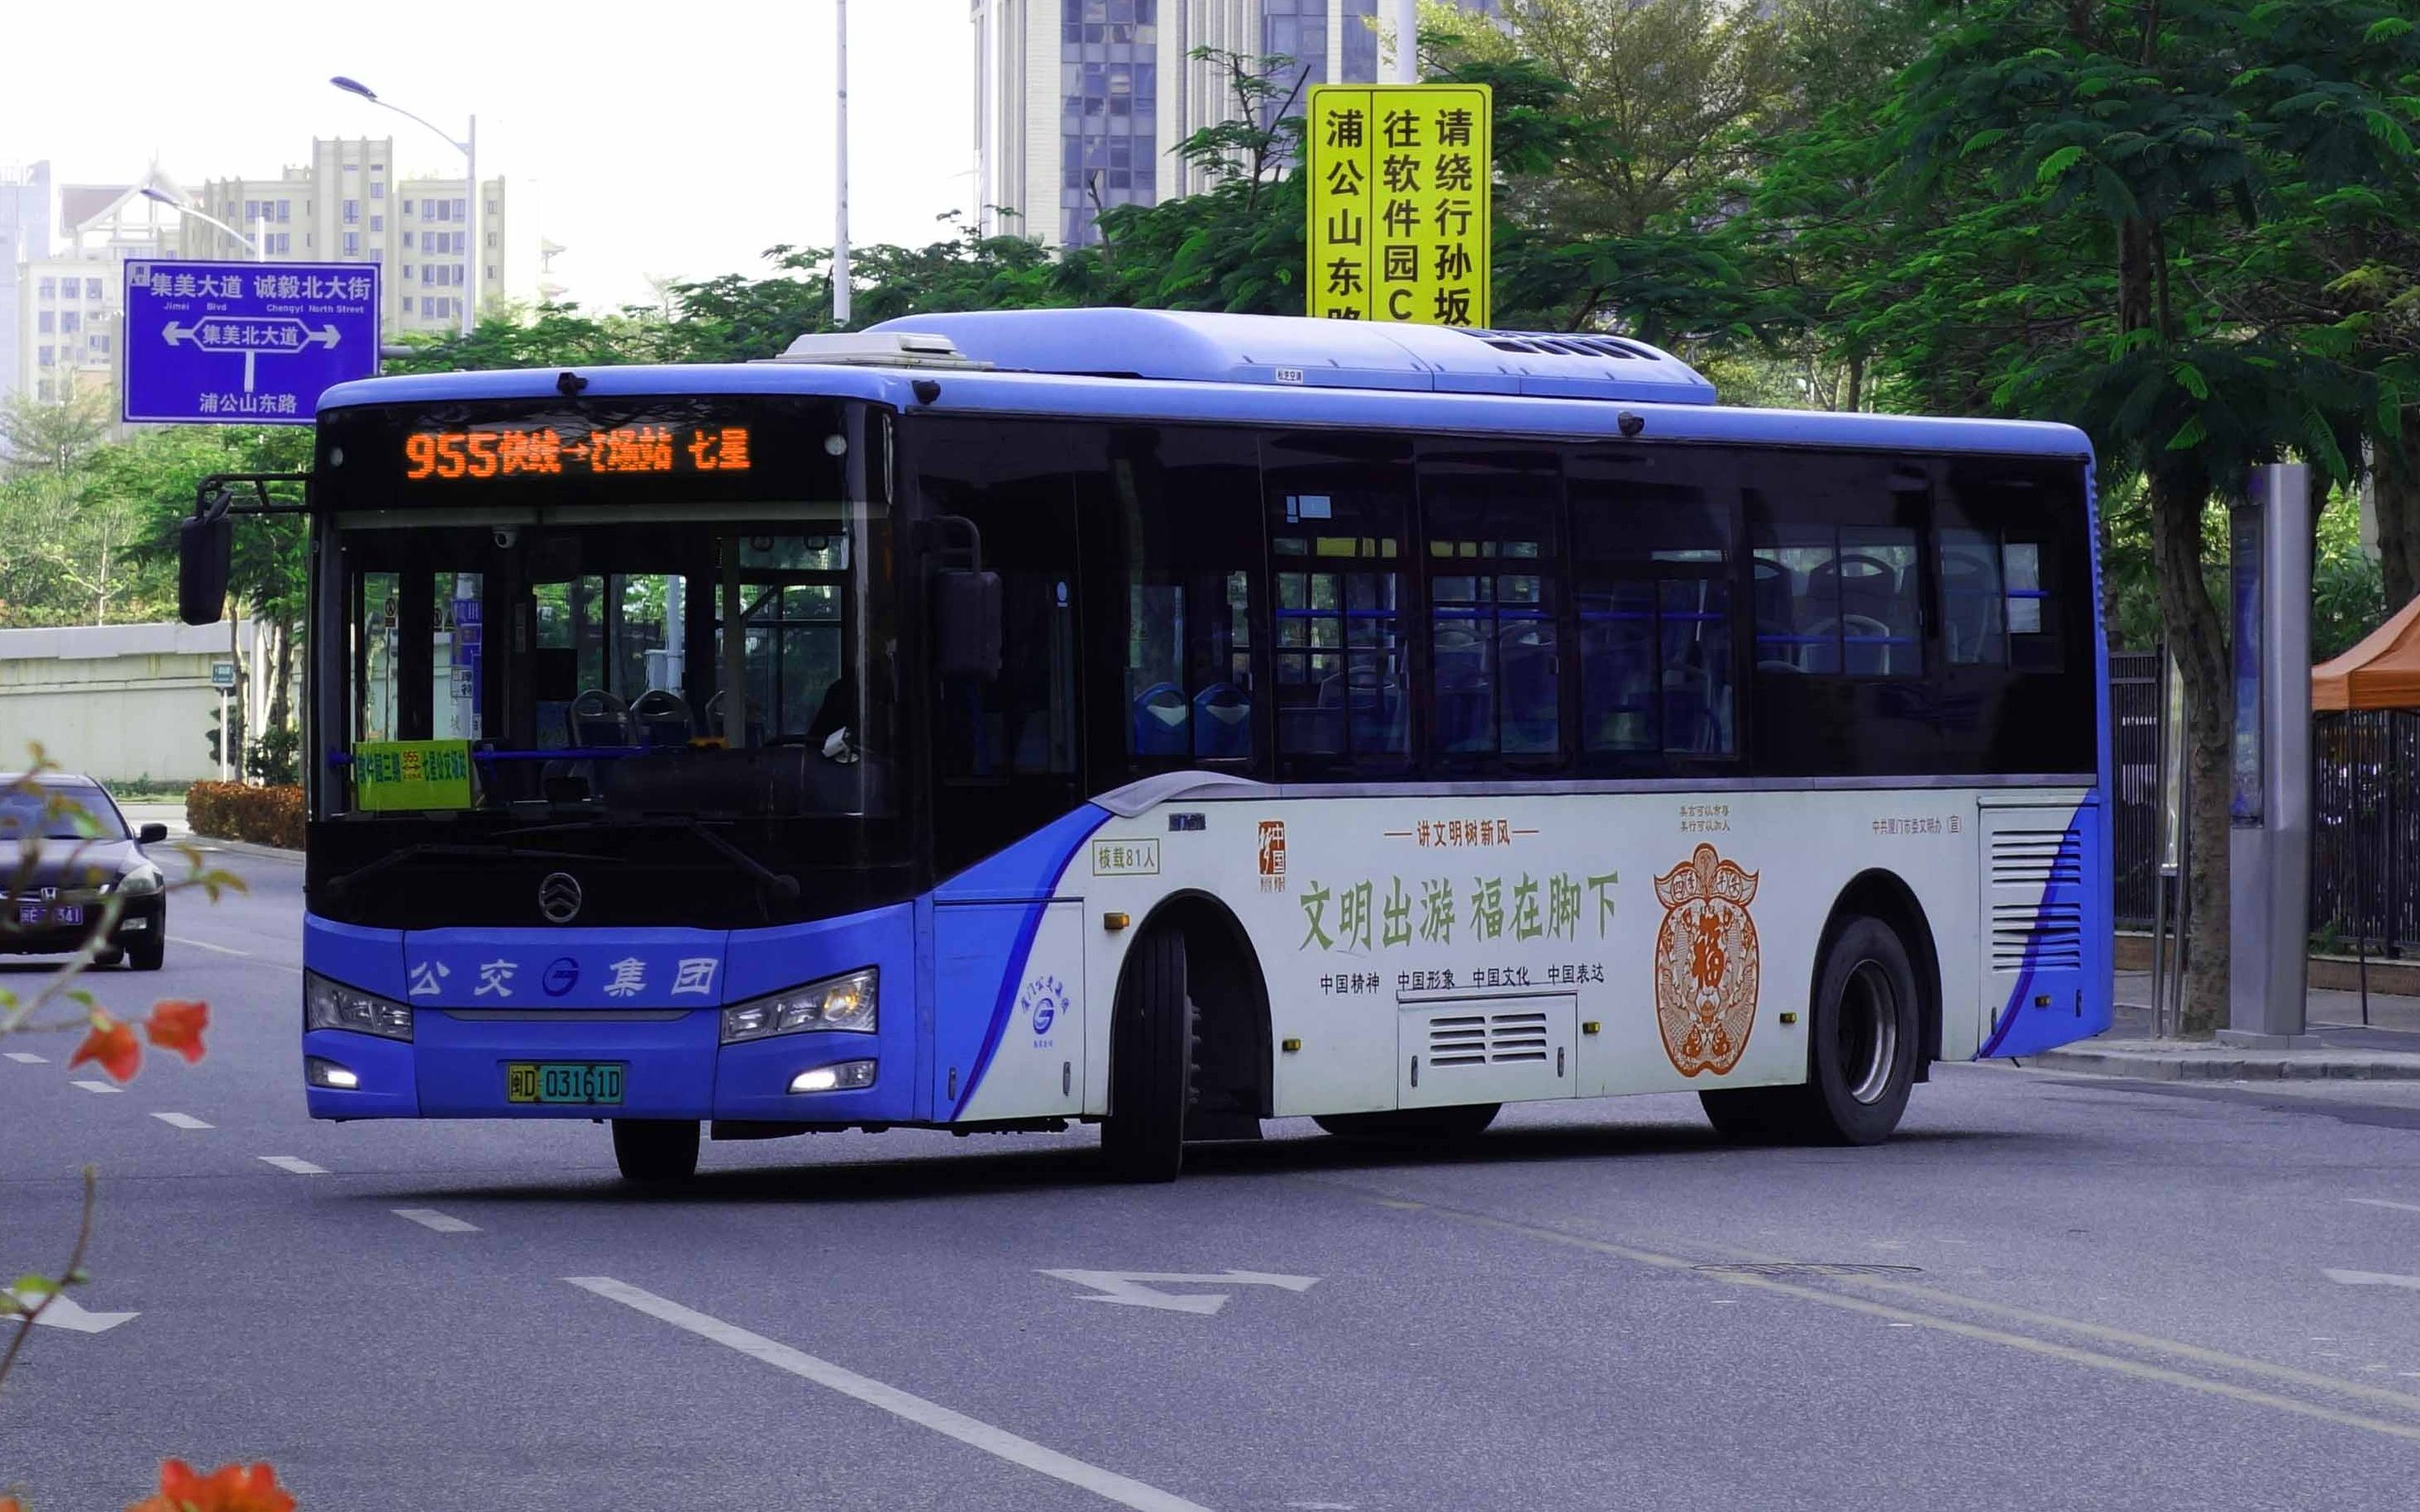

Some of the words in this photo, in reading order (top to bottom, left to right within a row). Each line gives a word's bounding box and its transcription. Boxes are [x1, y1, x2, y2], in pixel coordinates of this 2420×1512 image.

[1382, 110, 1420, 320] 往软件园C
[1434, 107, 1473, 326] 请绕行孙坂
[150, 274, 243, 298] 集美大道
[254, 275, 371, 300] 诚毅北大街
[164, 303, 189, 311] Jimei
[207, 303, 227, 311] Blvd
[308, 305, 333, 313] North
[337, 305, 364, 313] Street
[202, 325, 298, 346] 集美北大道
[199, 394, 298, 414] 浦公山东路
[1416, 820, 1511, 847] 讲文明树新风
[1099, 847, 1155, 869] 核载81人
[1300, 875, 1455, 952] 文明出游
[1470, 870, 1619, 942] 福在脚下
[1320, 971, 1380, 995] 中国精神
[1397, 970, 1455, 990] 中国形象
[1473, 966, 1530, 986] 中国文化
[1548, 963, 1604, 984] 中国表达
